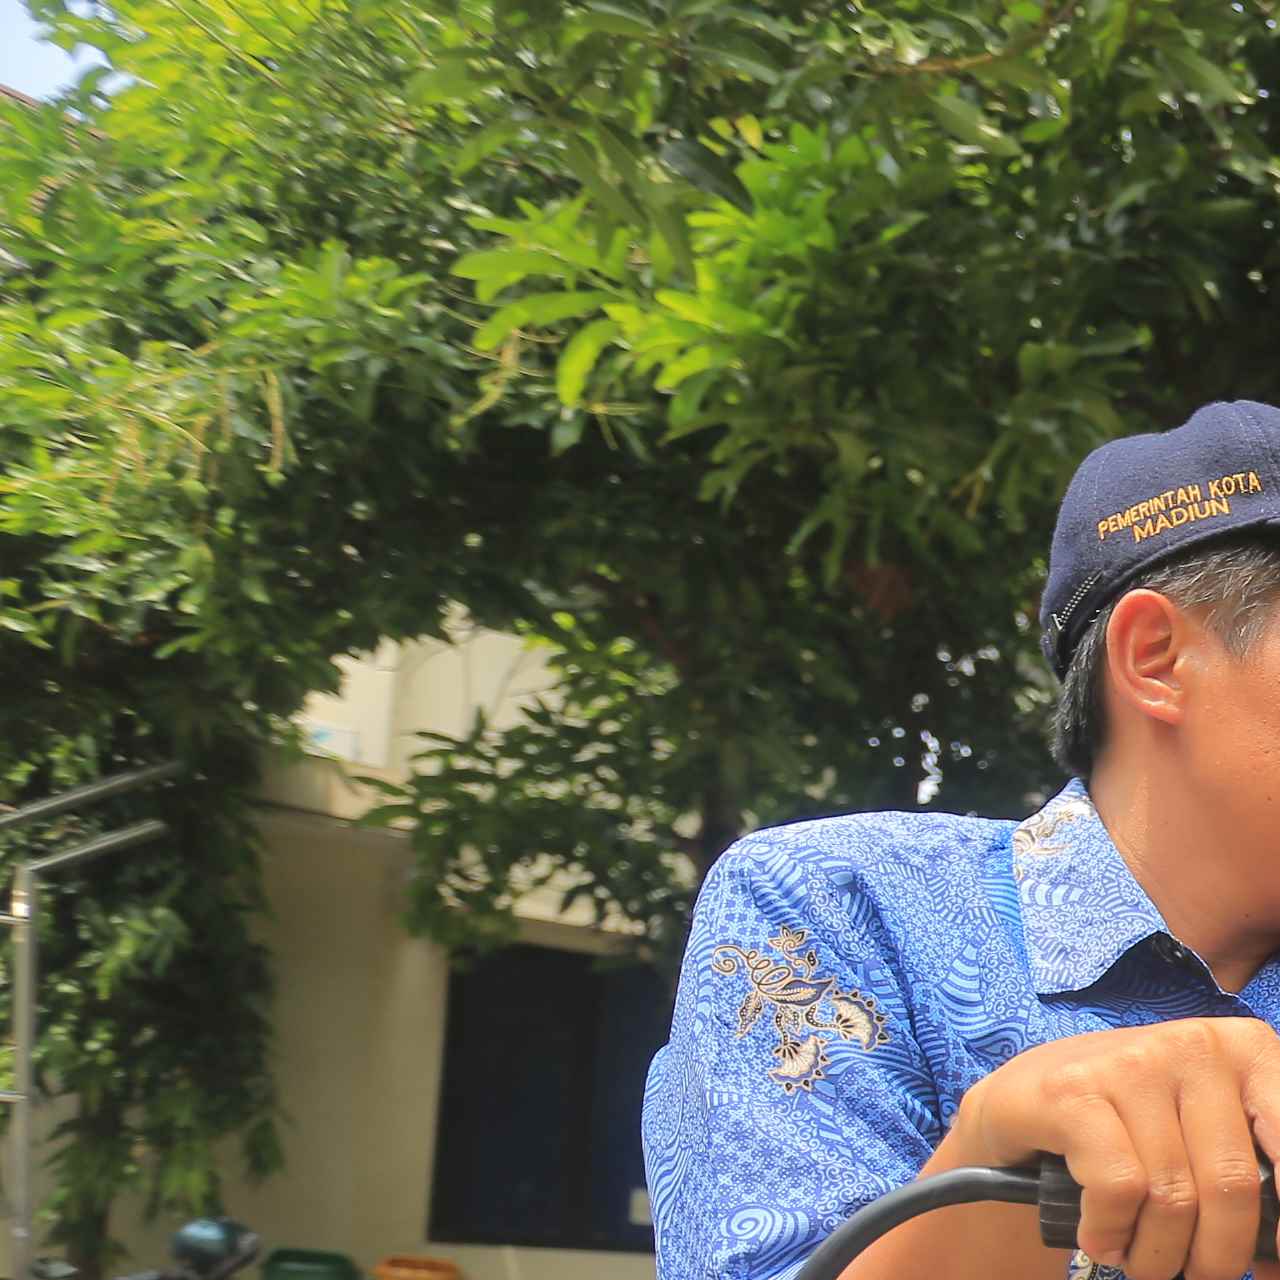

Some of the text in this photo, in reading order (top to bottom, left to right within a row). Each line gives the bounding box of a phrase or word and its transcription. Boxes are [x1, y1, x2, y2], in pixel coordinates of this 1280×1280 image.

[1097, 470, 1262, 541] PEMERINTAH KOTA
[1132, 498, 1231, 543] MADIUN
